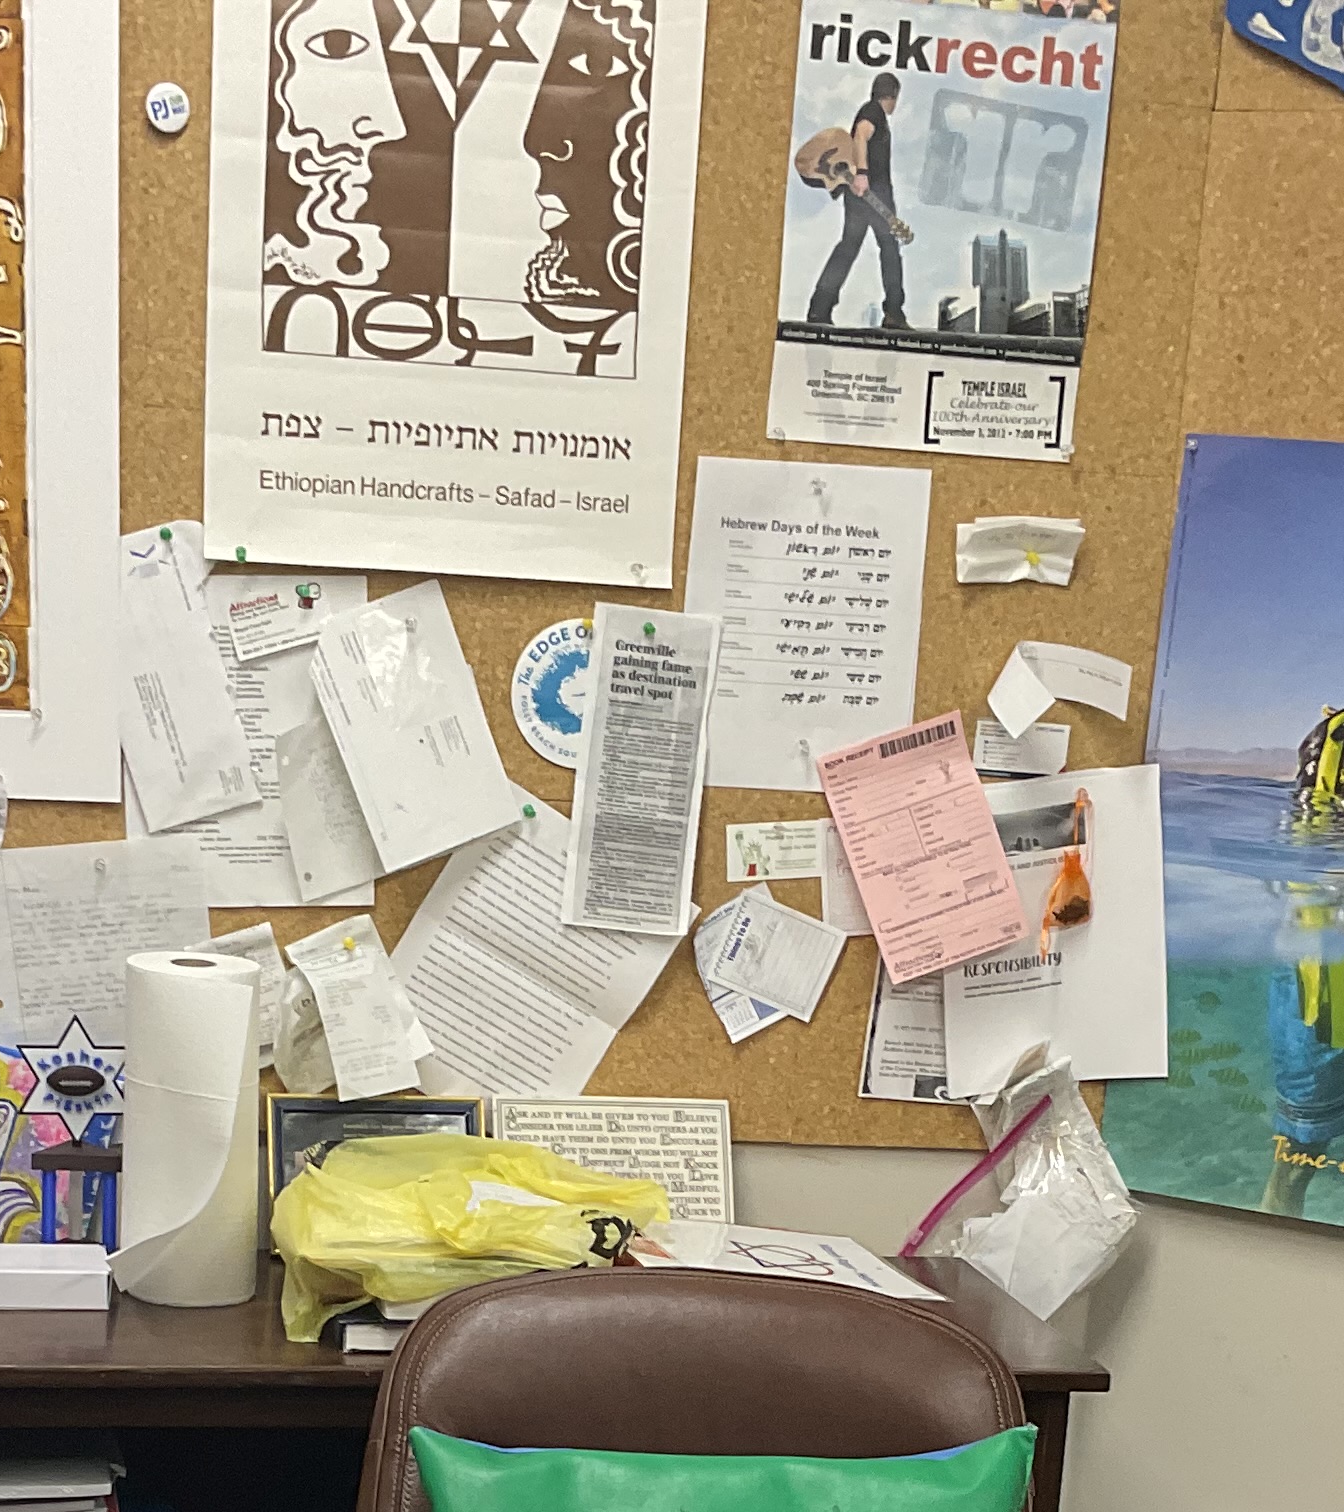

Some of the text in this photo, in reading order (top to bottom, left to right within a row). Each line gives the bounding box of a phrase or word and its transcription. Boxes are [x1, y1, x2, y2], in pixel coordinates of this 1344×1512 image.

[809, 13, 1103, 91] rickrecht
[150, 97, 169, 120] PJ
[961, 380, 1027, 398] TEMPLE ISRAEL
[950, 397, 1010, 411] Celebrate
[261, 411, 632, 461] אומנויות אתיופיות צפת
[933, 427, 976, 438] November
[259, 469, 630, 514] Ethiopian Handcrafts Safad Israel
[720, 516, 881, 539] Hebrew Days of the Week
[528, 627, 571, 663] EDGE
[615, 639, 677, 658] Greenville
[613, 655, 693, 674] gaining fame
[611, 670, 697, 689] as destination
[610, 681, 674, 701] travel spot
[963, 952, 1062, 978] RESPONSIBILTY
